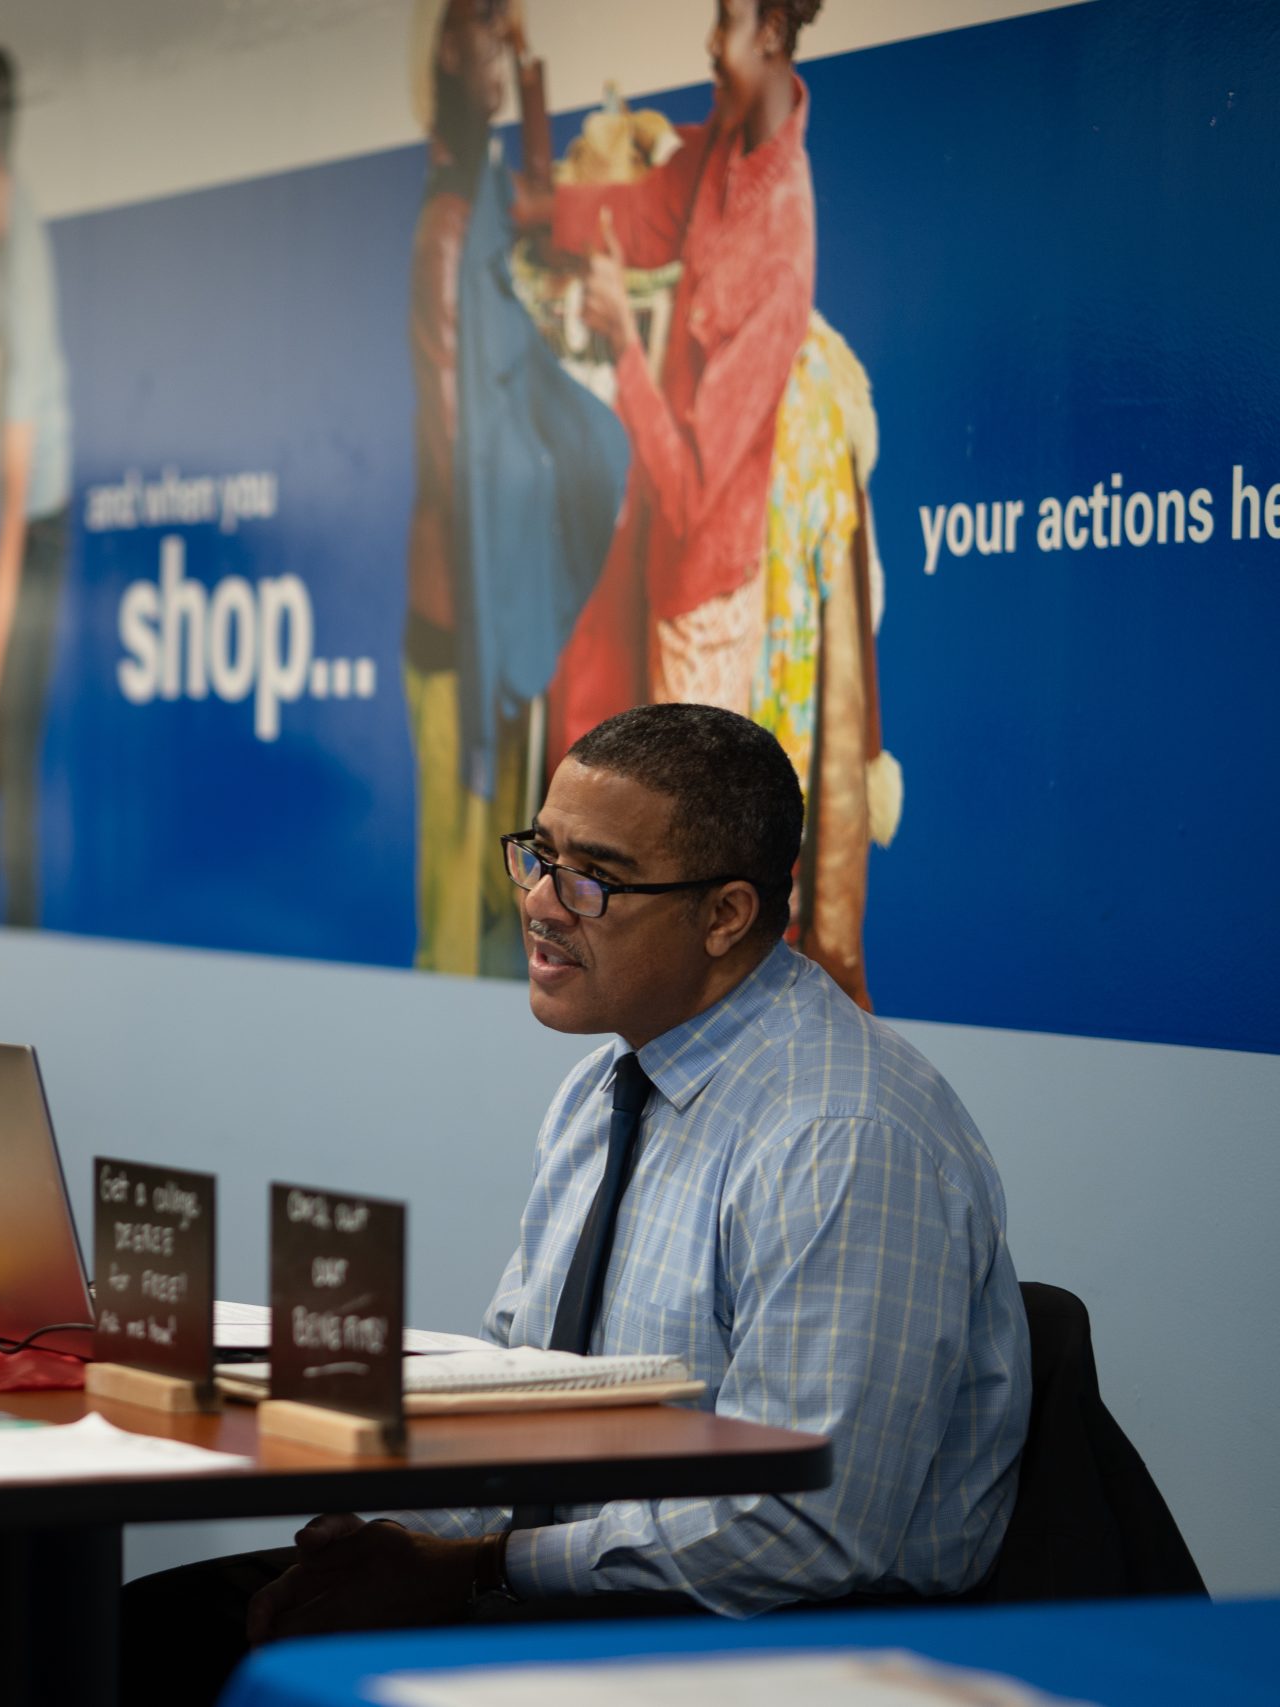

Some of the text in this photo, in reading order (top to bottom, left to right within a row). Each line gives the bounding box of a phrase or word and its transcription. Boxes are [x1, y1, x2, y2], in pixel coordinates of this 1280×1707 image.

[86, 470, 141, 532] and
[220, 475, 276, 534] you
[919, 498, 1024, 575] your
[1036, 472, 1214, 552] actions
[118, 534, 377, 743] shop...
